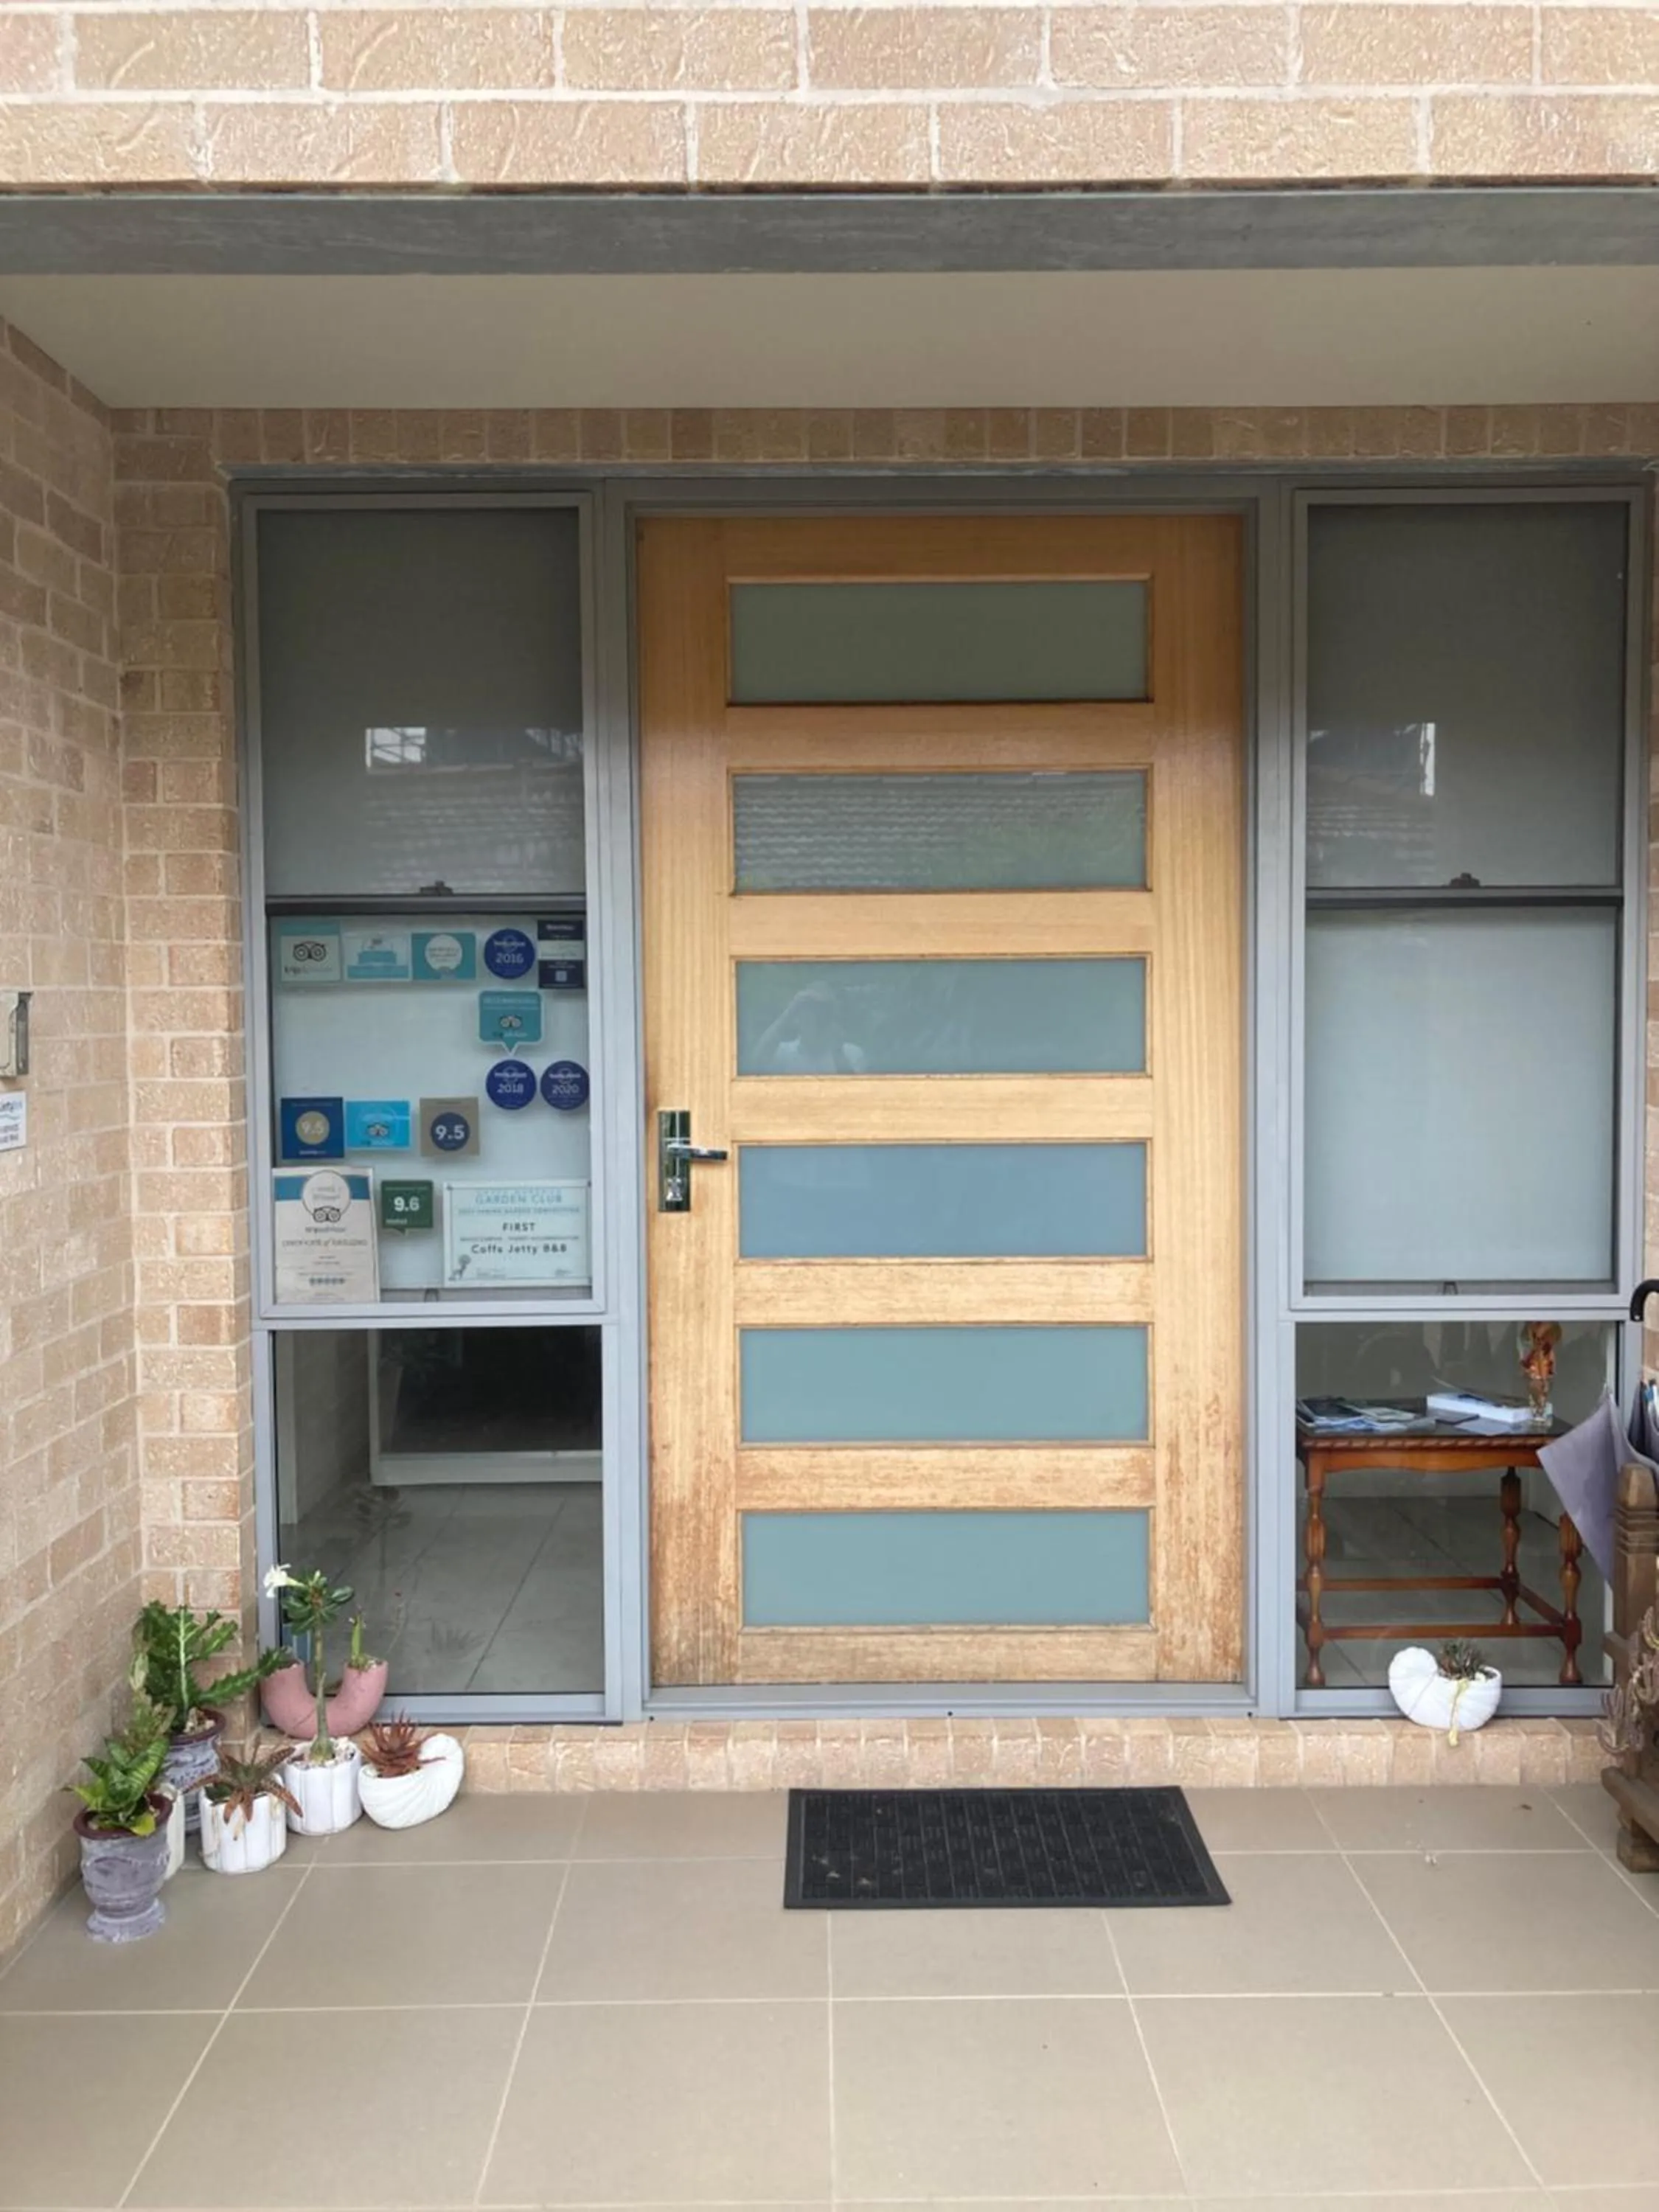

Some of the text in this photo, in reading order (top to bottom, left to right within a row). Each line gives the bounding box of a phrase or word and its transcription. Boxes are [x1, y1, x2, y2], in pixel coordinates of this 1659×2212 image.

[496, 953, 524, 964] 2016
[302, 1121, 324, 1135] 9.5
[435, 1124, 465, 1140] 9.5
[393, 1196, 420, 1211] 9.6
[502, 1222, 536, 1232] FIRST
